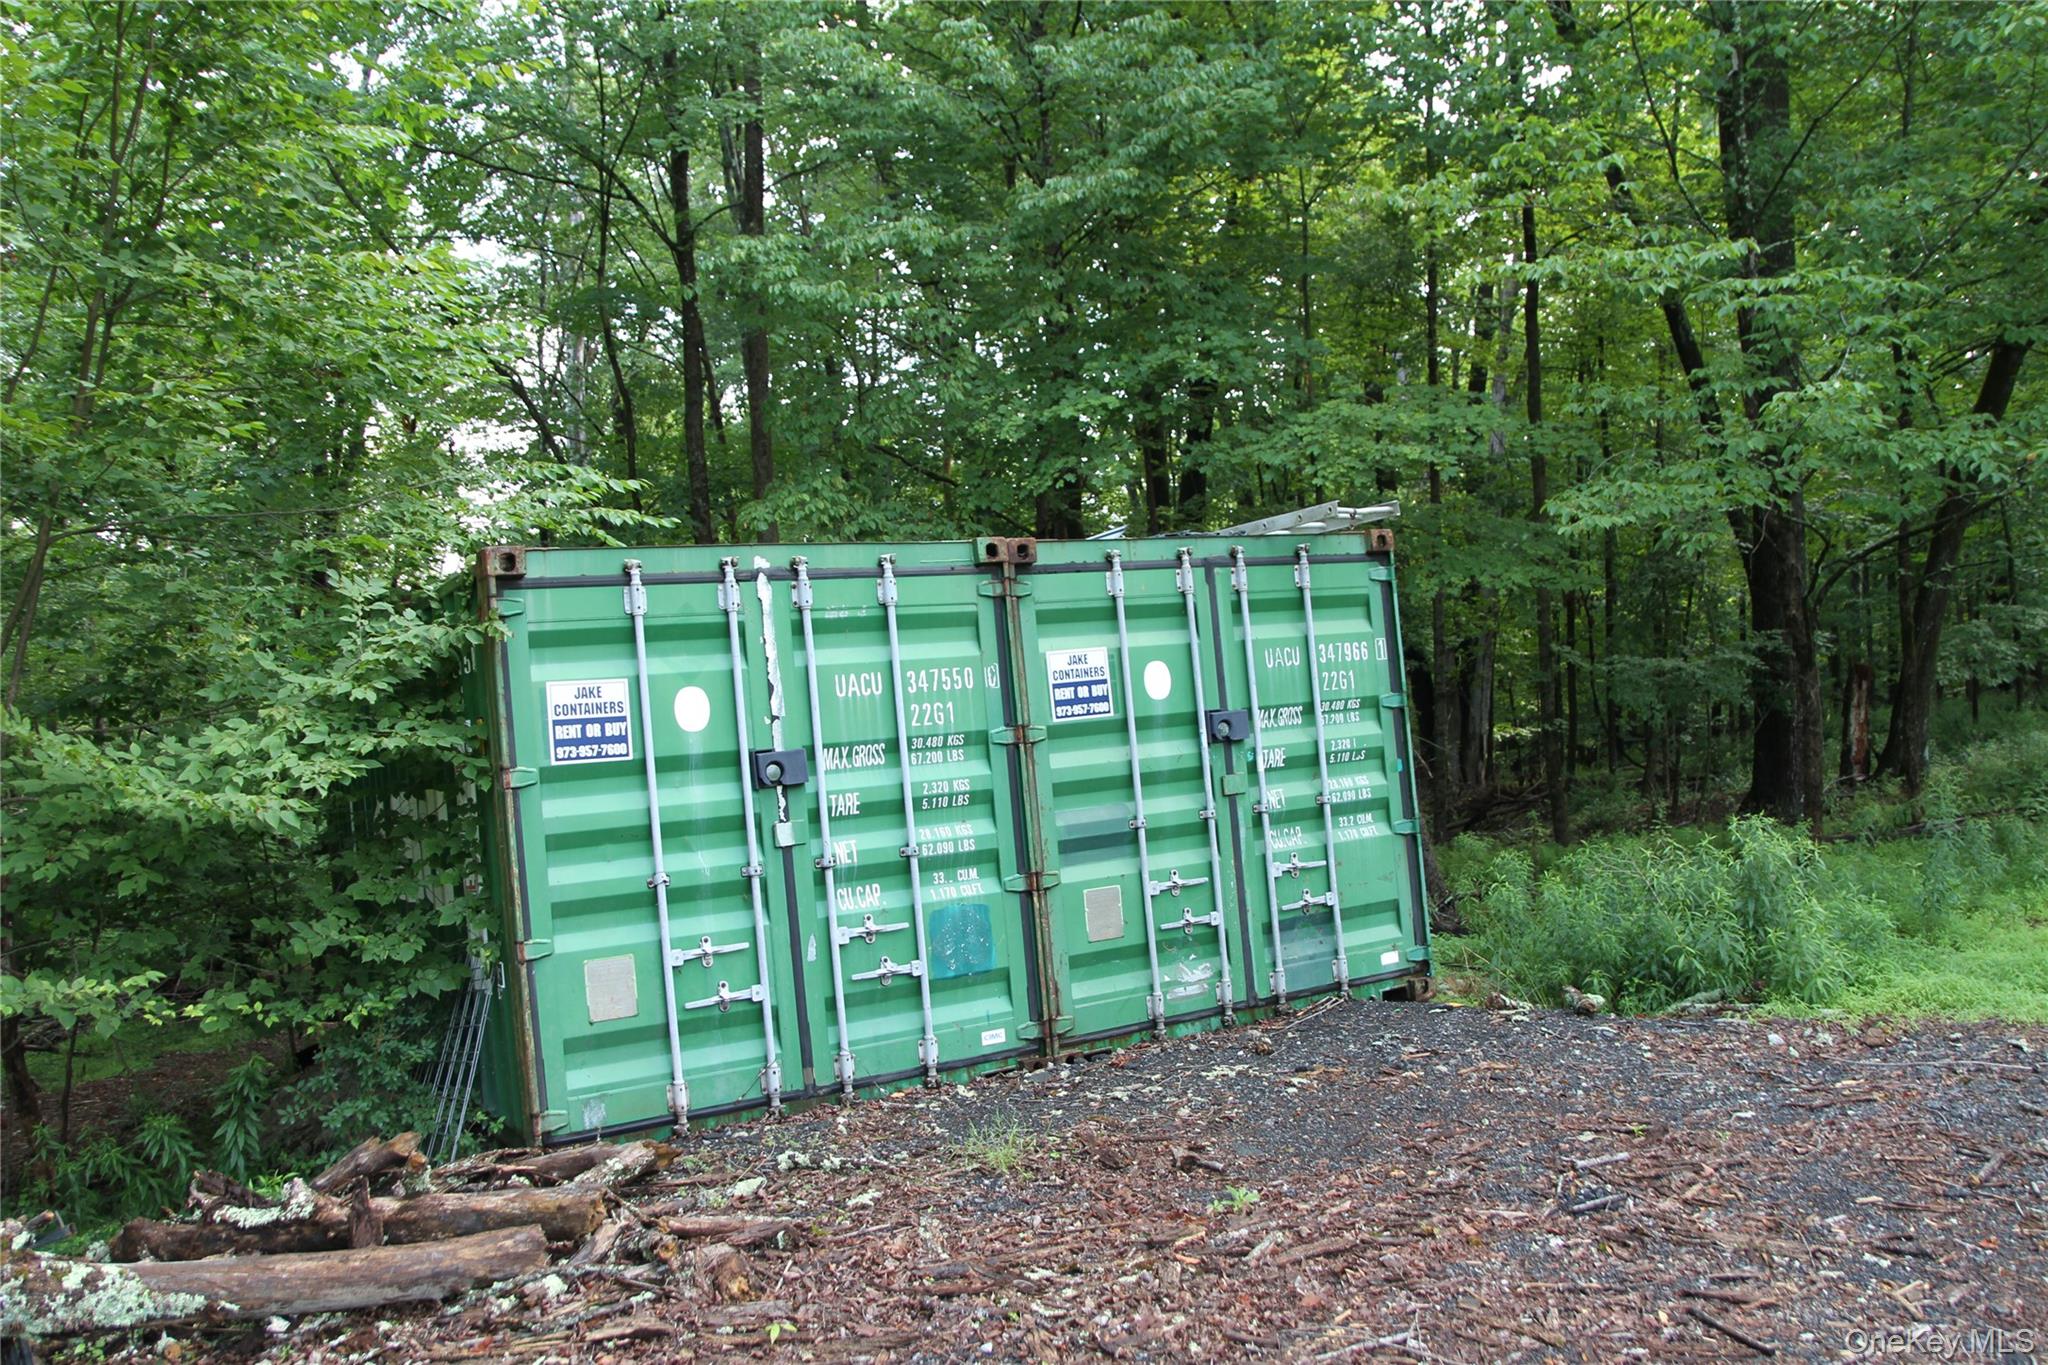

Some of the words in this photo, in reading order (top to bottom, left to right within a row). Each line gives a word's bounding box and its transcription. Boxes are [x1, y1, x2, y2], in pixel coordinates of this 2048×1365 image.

[1067, 654, 1088, 666] JAKE
[1264, 646, 1300, 669] UACU
[1319, 641, 1369, 664] 347966
[1053, 666, 1105, 681] CONTAINERS
[1322, 670, 1355, 691] 22G1
[835, 672, 883, 698] UACU
[907, 667, 974, 693] 347550
[574, 686, 602, 699] JAKE
[1054, 687, 1075, 700] RENT
[1077, 685, 1089, 698] OR
[1091, 684, 1108, 697] BUY
[554, 701, 624, 717] CONTAINERS
[911, 701, 955, 727] 22G1
[555, 724, 582, 739] RENT
[586, 723, 601, 738] OR
[605, 722, 627, 736] BUY
[556, 743, 627, 759] 973-957-7600
[823, 743, 886, 771] MAX.GROSS
[911, 735, 944, 750] 30.480
[947, 734, 965, 746] KGS
[911, 751, 943, 765] 67.200
[946, 749, 964, 762] LBS
[1262, 747, 1286, 768] TARE
[829, 792, 861, 817] TARE
[922, 781, 949, 795] 2.320
[952, 779, 970, 792] KGS
[922, 796, 948, 810] 5.110
[952, 794, 970, 807] LBS
[1267, 788, 1286, 809] NET
[1358, 788, 1372, 800] LBS
[834, 840, 858, 865] NET
[954, 824, 974, 836] KGS
[922, 841, 954, 856] 62.090
[958, 839, 976, 852] LBS
